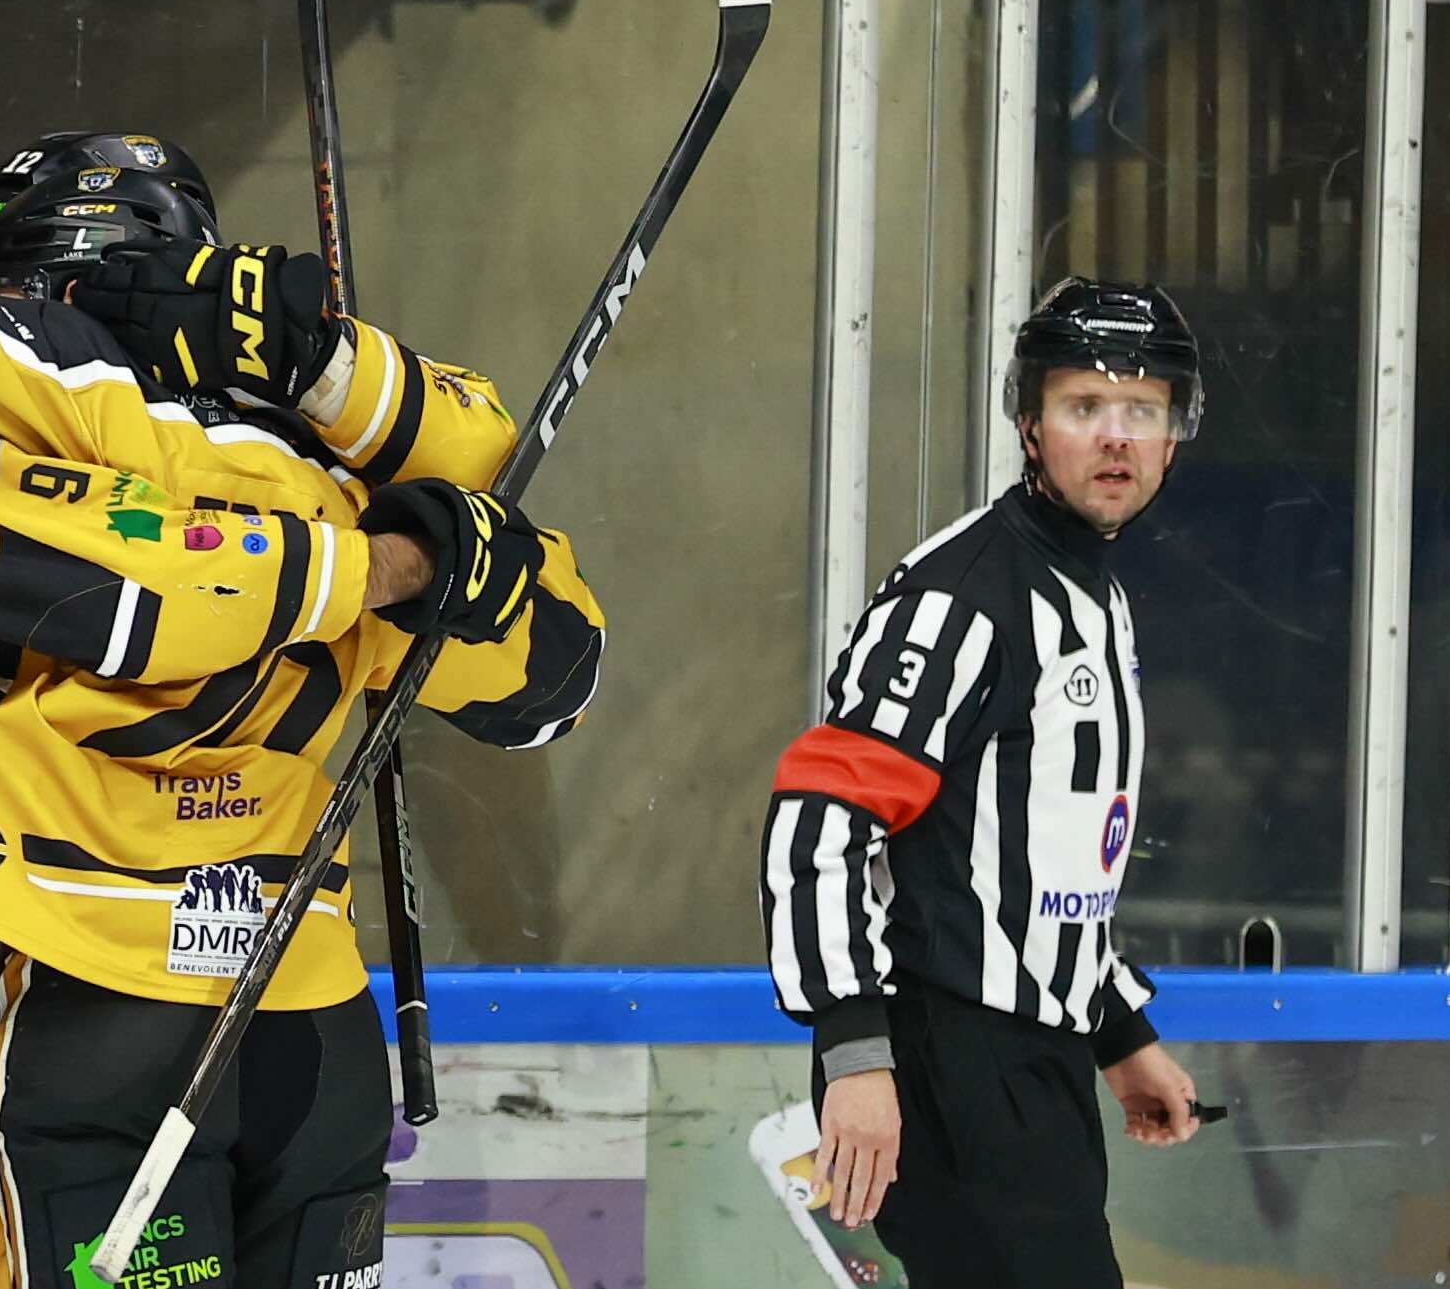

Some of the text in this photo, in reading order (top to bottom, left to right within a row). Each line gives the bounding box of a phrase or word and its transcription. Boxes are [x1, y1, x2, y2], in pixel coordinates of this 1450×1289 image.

[3, 151, 45, 175] 12
[62, 204, 119, 217] CCM
[231, 245, 269, 381] CM
[539, 242, 647, 452] CCM
[888, 648, 927, 700] 3
[138, 1215, 186, 1245] NCS
